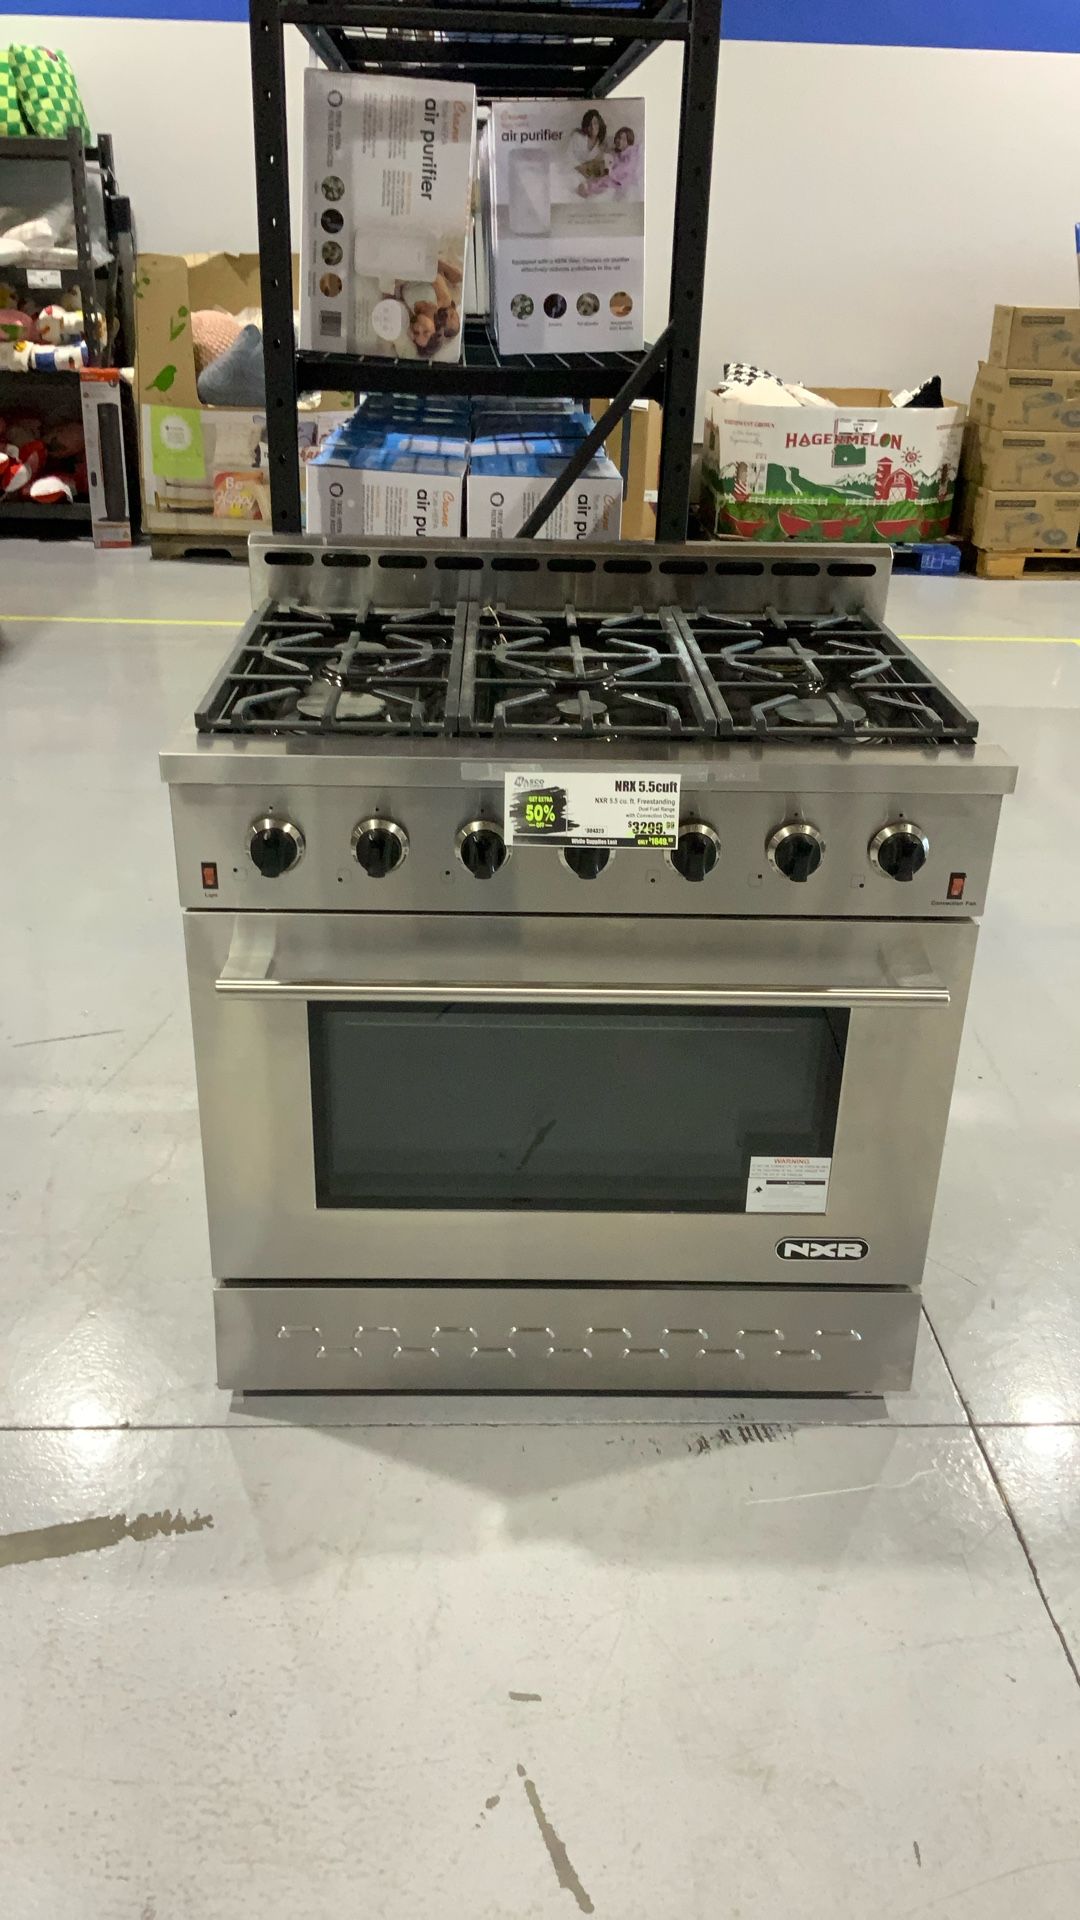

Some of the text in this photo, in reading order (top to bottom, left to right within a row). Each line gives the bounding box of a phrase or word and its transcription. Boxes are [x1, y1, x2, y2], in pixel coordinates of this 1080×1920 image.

[502, 128, 562, 144] air purifier
[420, 98, 439, 200] air purifier
[416, 489, 430, 511] air
[442, 490, 455, 528] Crane
[577, 494, 590, 516] air
[614, 780, 678, 793] NRX 5.5cuft
[637, 798, 676, 806] Freestanding
[526, 804, 556, 822] 50%
[784, 1242, 862, 1258] NXR
